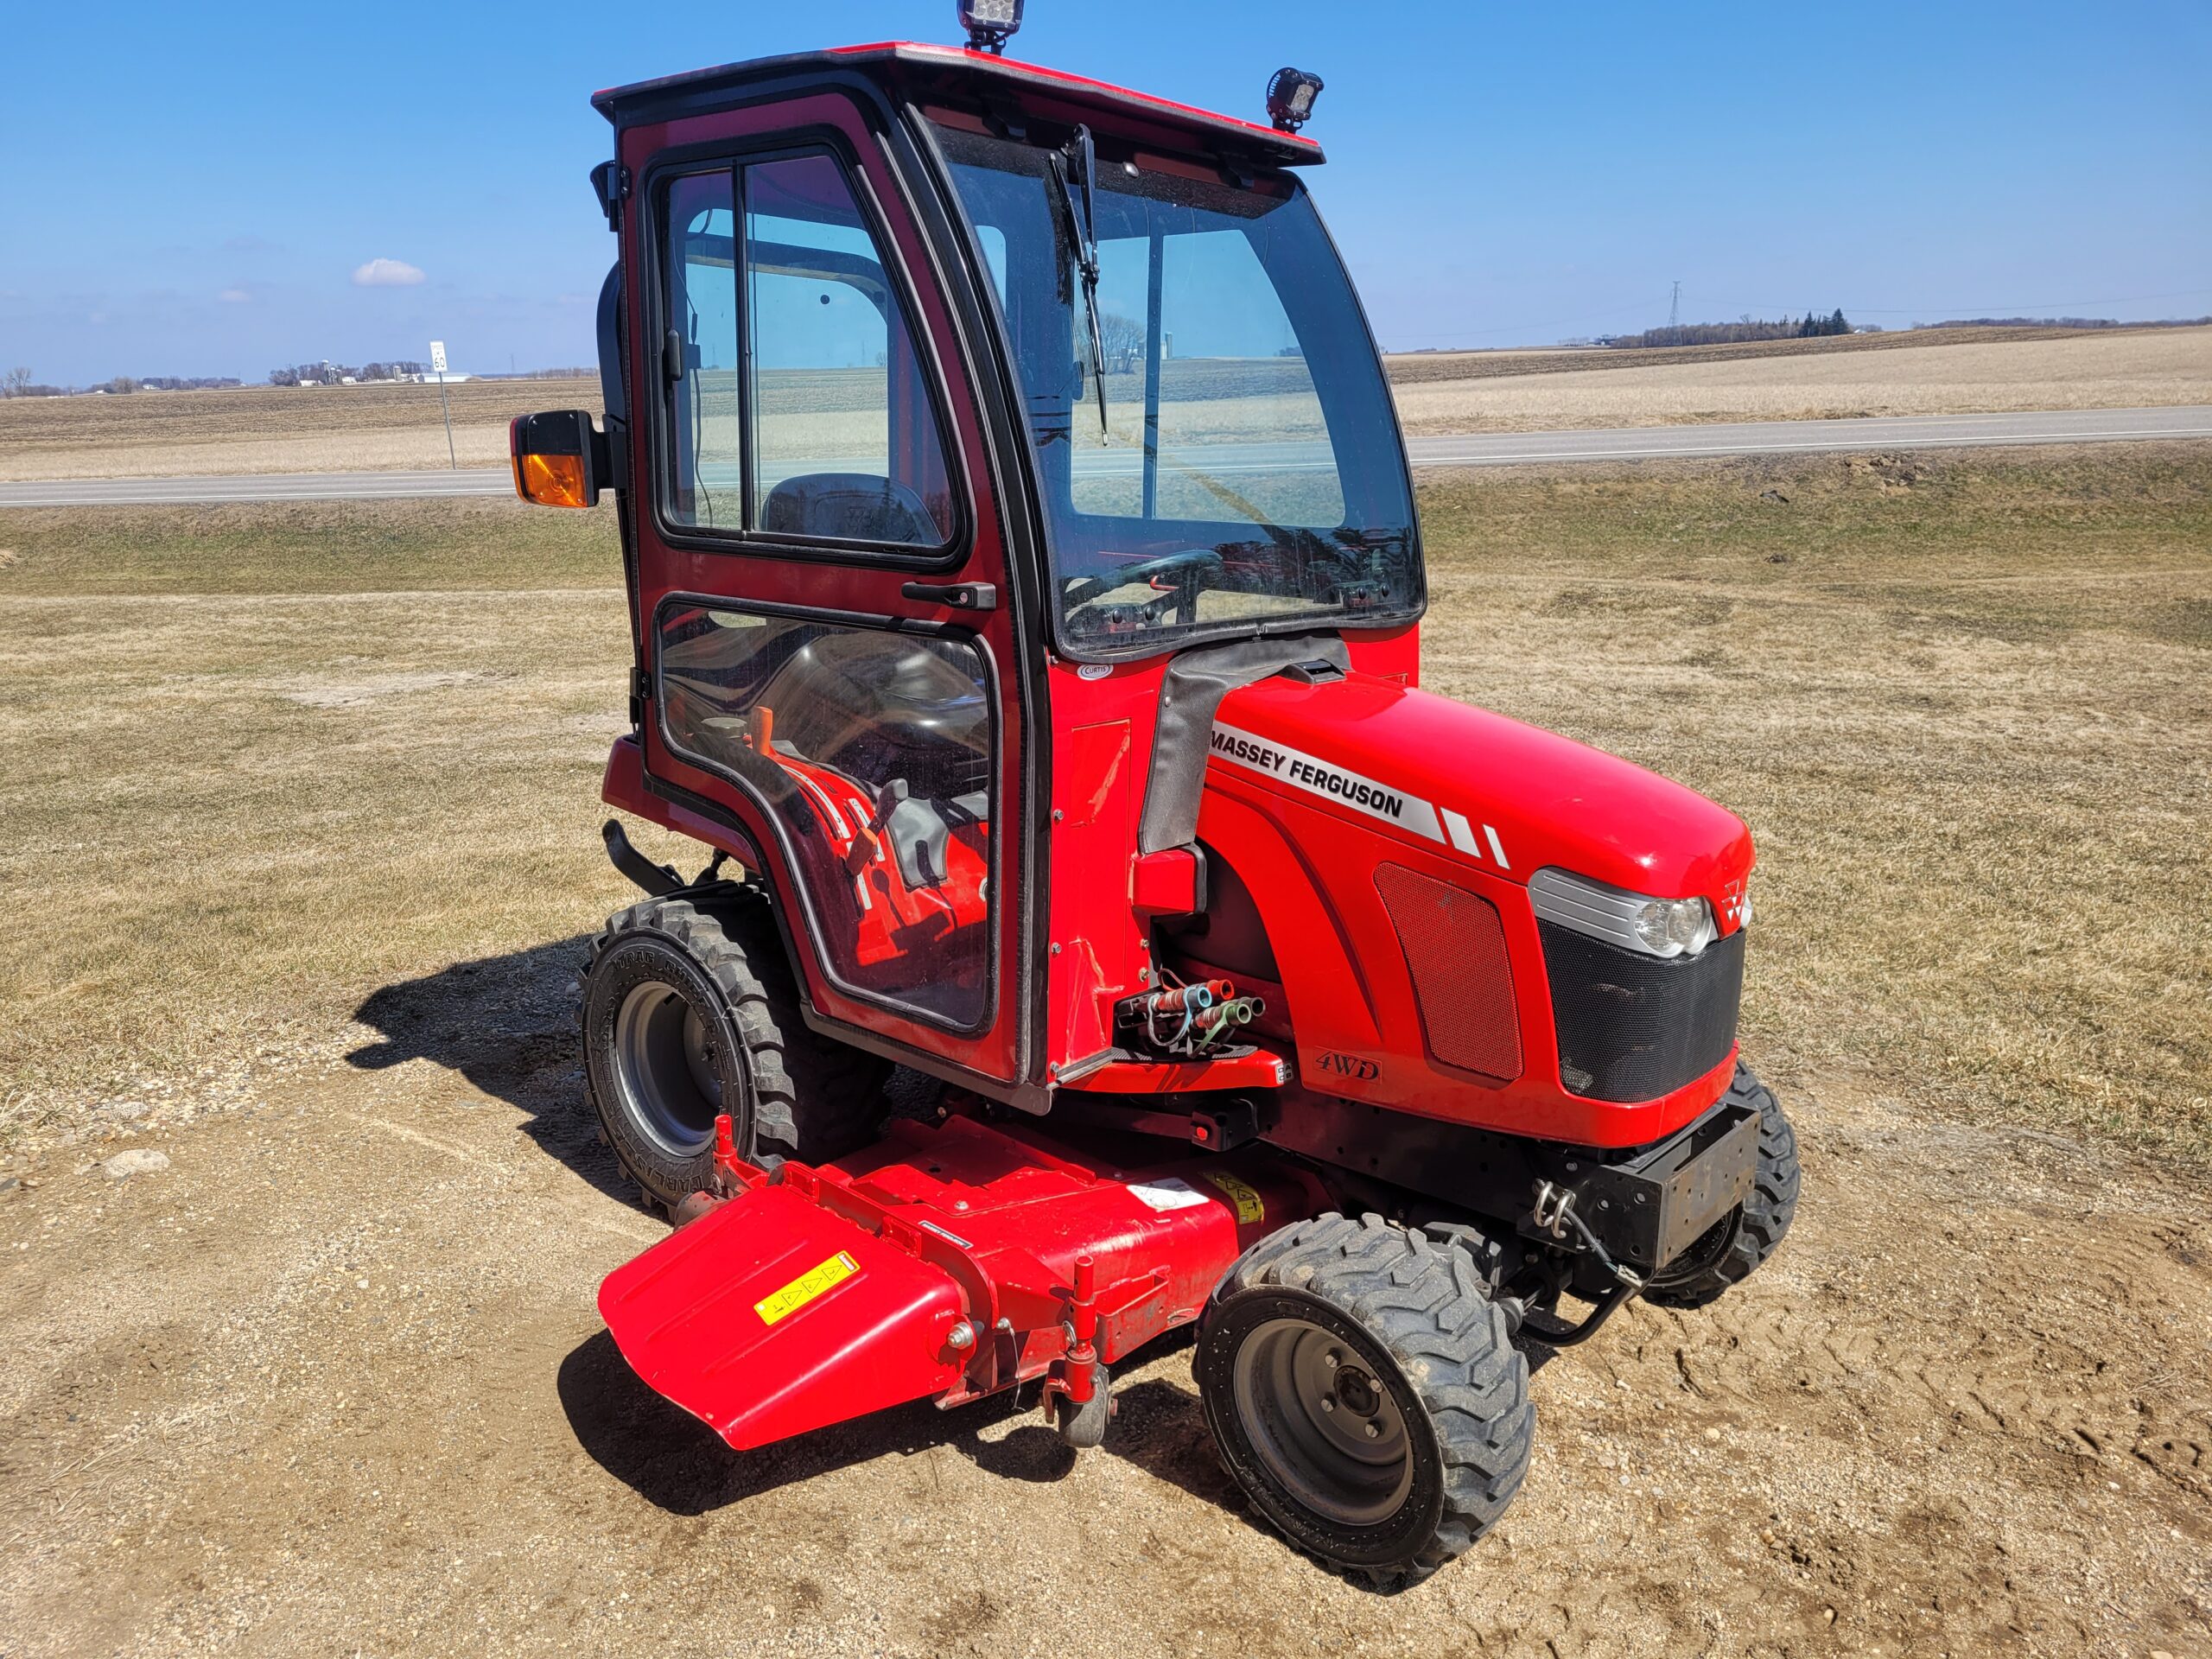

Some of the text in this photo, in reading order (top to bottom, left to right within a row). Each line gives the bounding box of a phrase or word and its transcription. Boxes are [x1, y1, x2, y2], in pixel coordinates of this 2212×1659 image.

[435, 357, 445, 368] 60
[1084, 665, 1106, 675] CURTIS
[1210, 730, 1403, 818] MASSEY FERGUSON
[1315, 1051, 1379, 1080] 4WD
